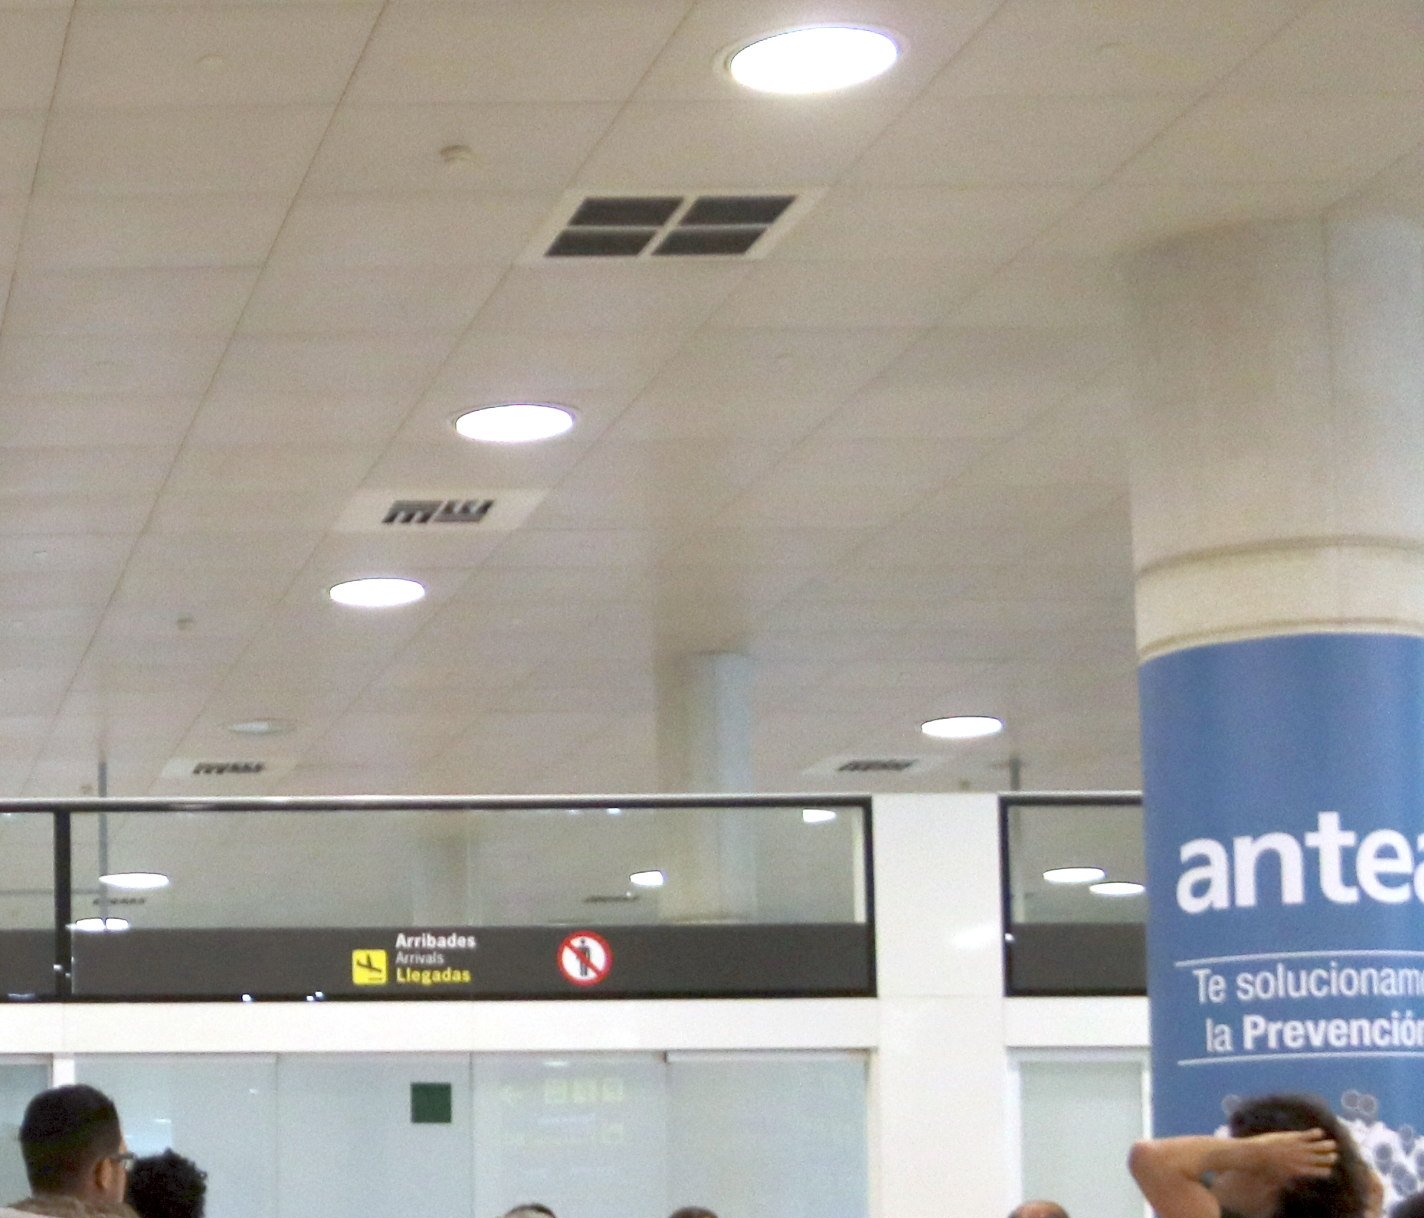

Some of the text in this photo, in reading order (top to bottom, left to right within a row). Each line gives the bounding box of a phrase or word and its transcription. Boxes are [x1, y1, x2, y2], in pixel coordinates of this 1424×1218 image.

[1176, 810, 1424, 915] ante
[395, 933, 476, 948] Arribades
[395, 951, 445, 965] Arrivals
[396, 967, 472, 985] Llegadas
[1193, 961, 1424, 1003] Te solucionam
[1206, 1017, 1233, 1052] la
